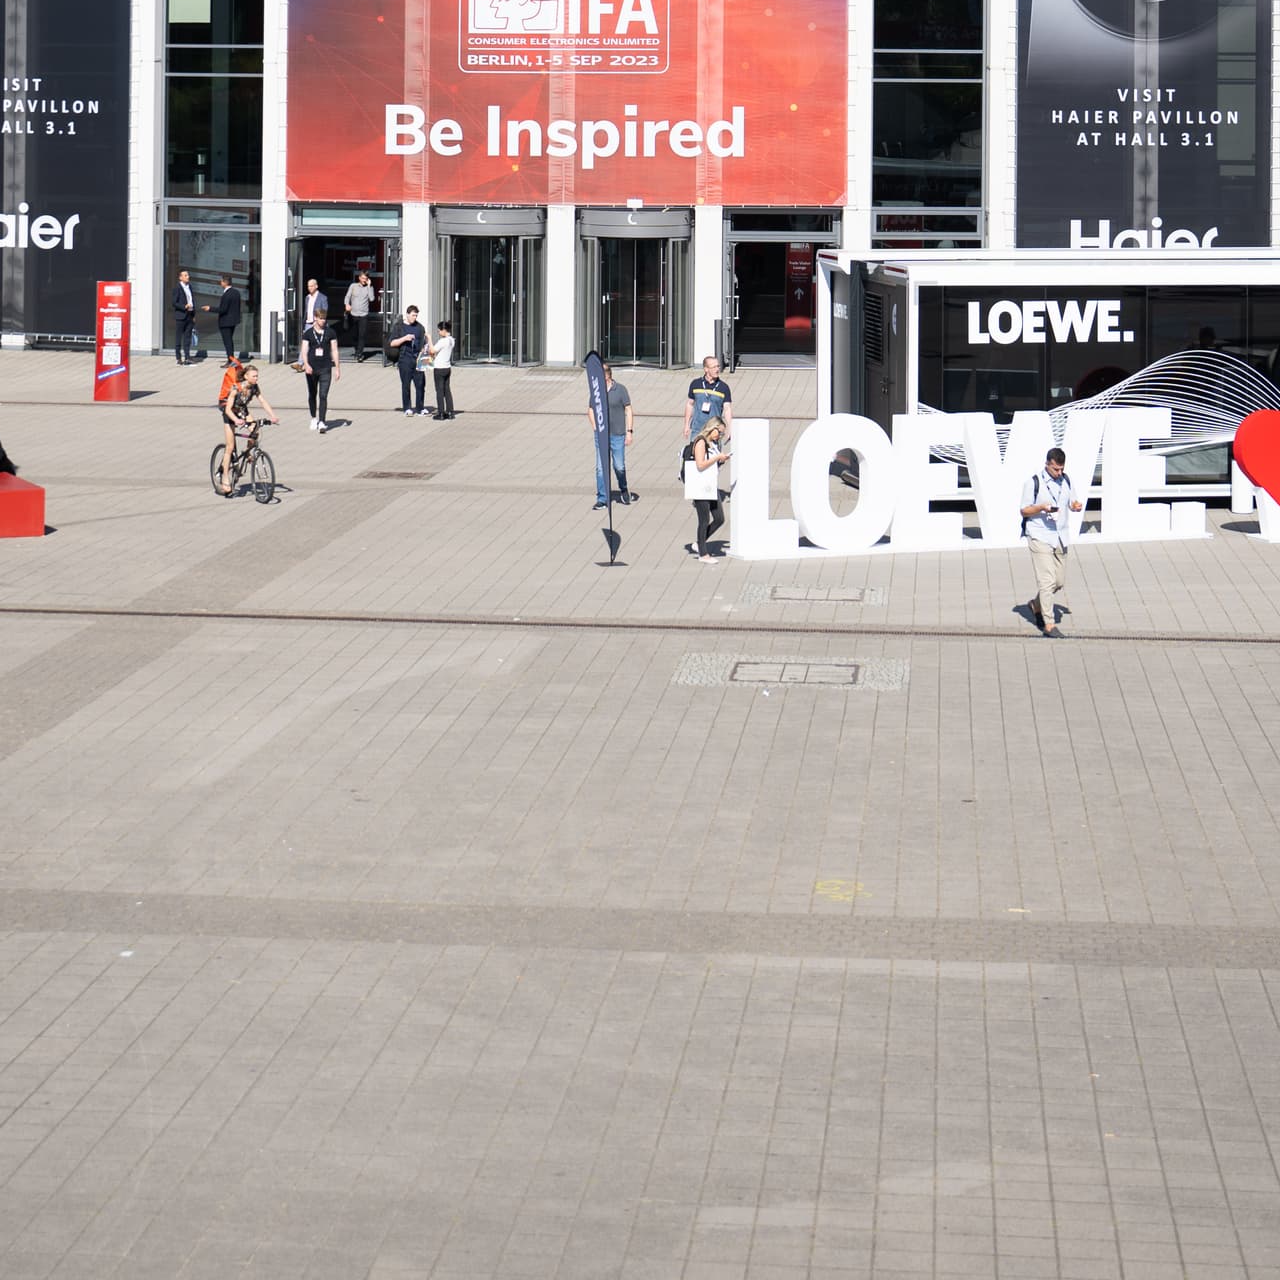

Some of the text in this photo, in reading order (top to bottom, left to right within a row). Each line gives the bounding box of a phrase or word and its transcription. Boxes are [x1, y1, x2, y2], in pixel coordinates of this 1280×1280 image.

[467, 37, 661, 46] CONSUMER ELECTRONICS UNLIMITED
[467, 55, 660, 68] BERLIN, 1-5 SEP 2023
[1117, 88, 1176, 102] VISIT
[3, 99, 100, 114] PAVILLON
[1051, 109, 1239, 125] HAIER PAVILLON
[45, 121, 77, 135] 3.1
[384, 104, 746, 169] Be Inspired
[1076, 131, 1215, 147] AT HALL 3.1
[968, 299, 1135, 344] LOEWE.
